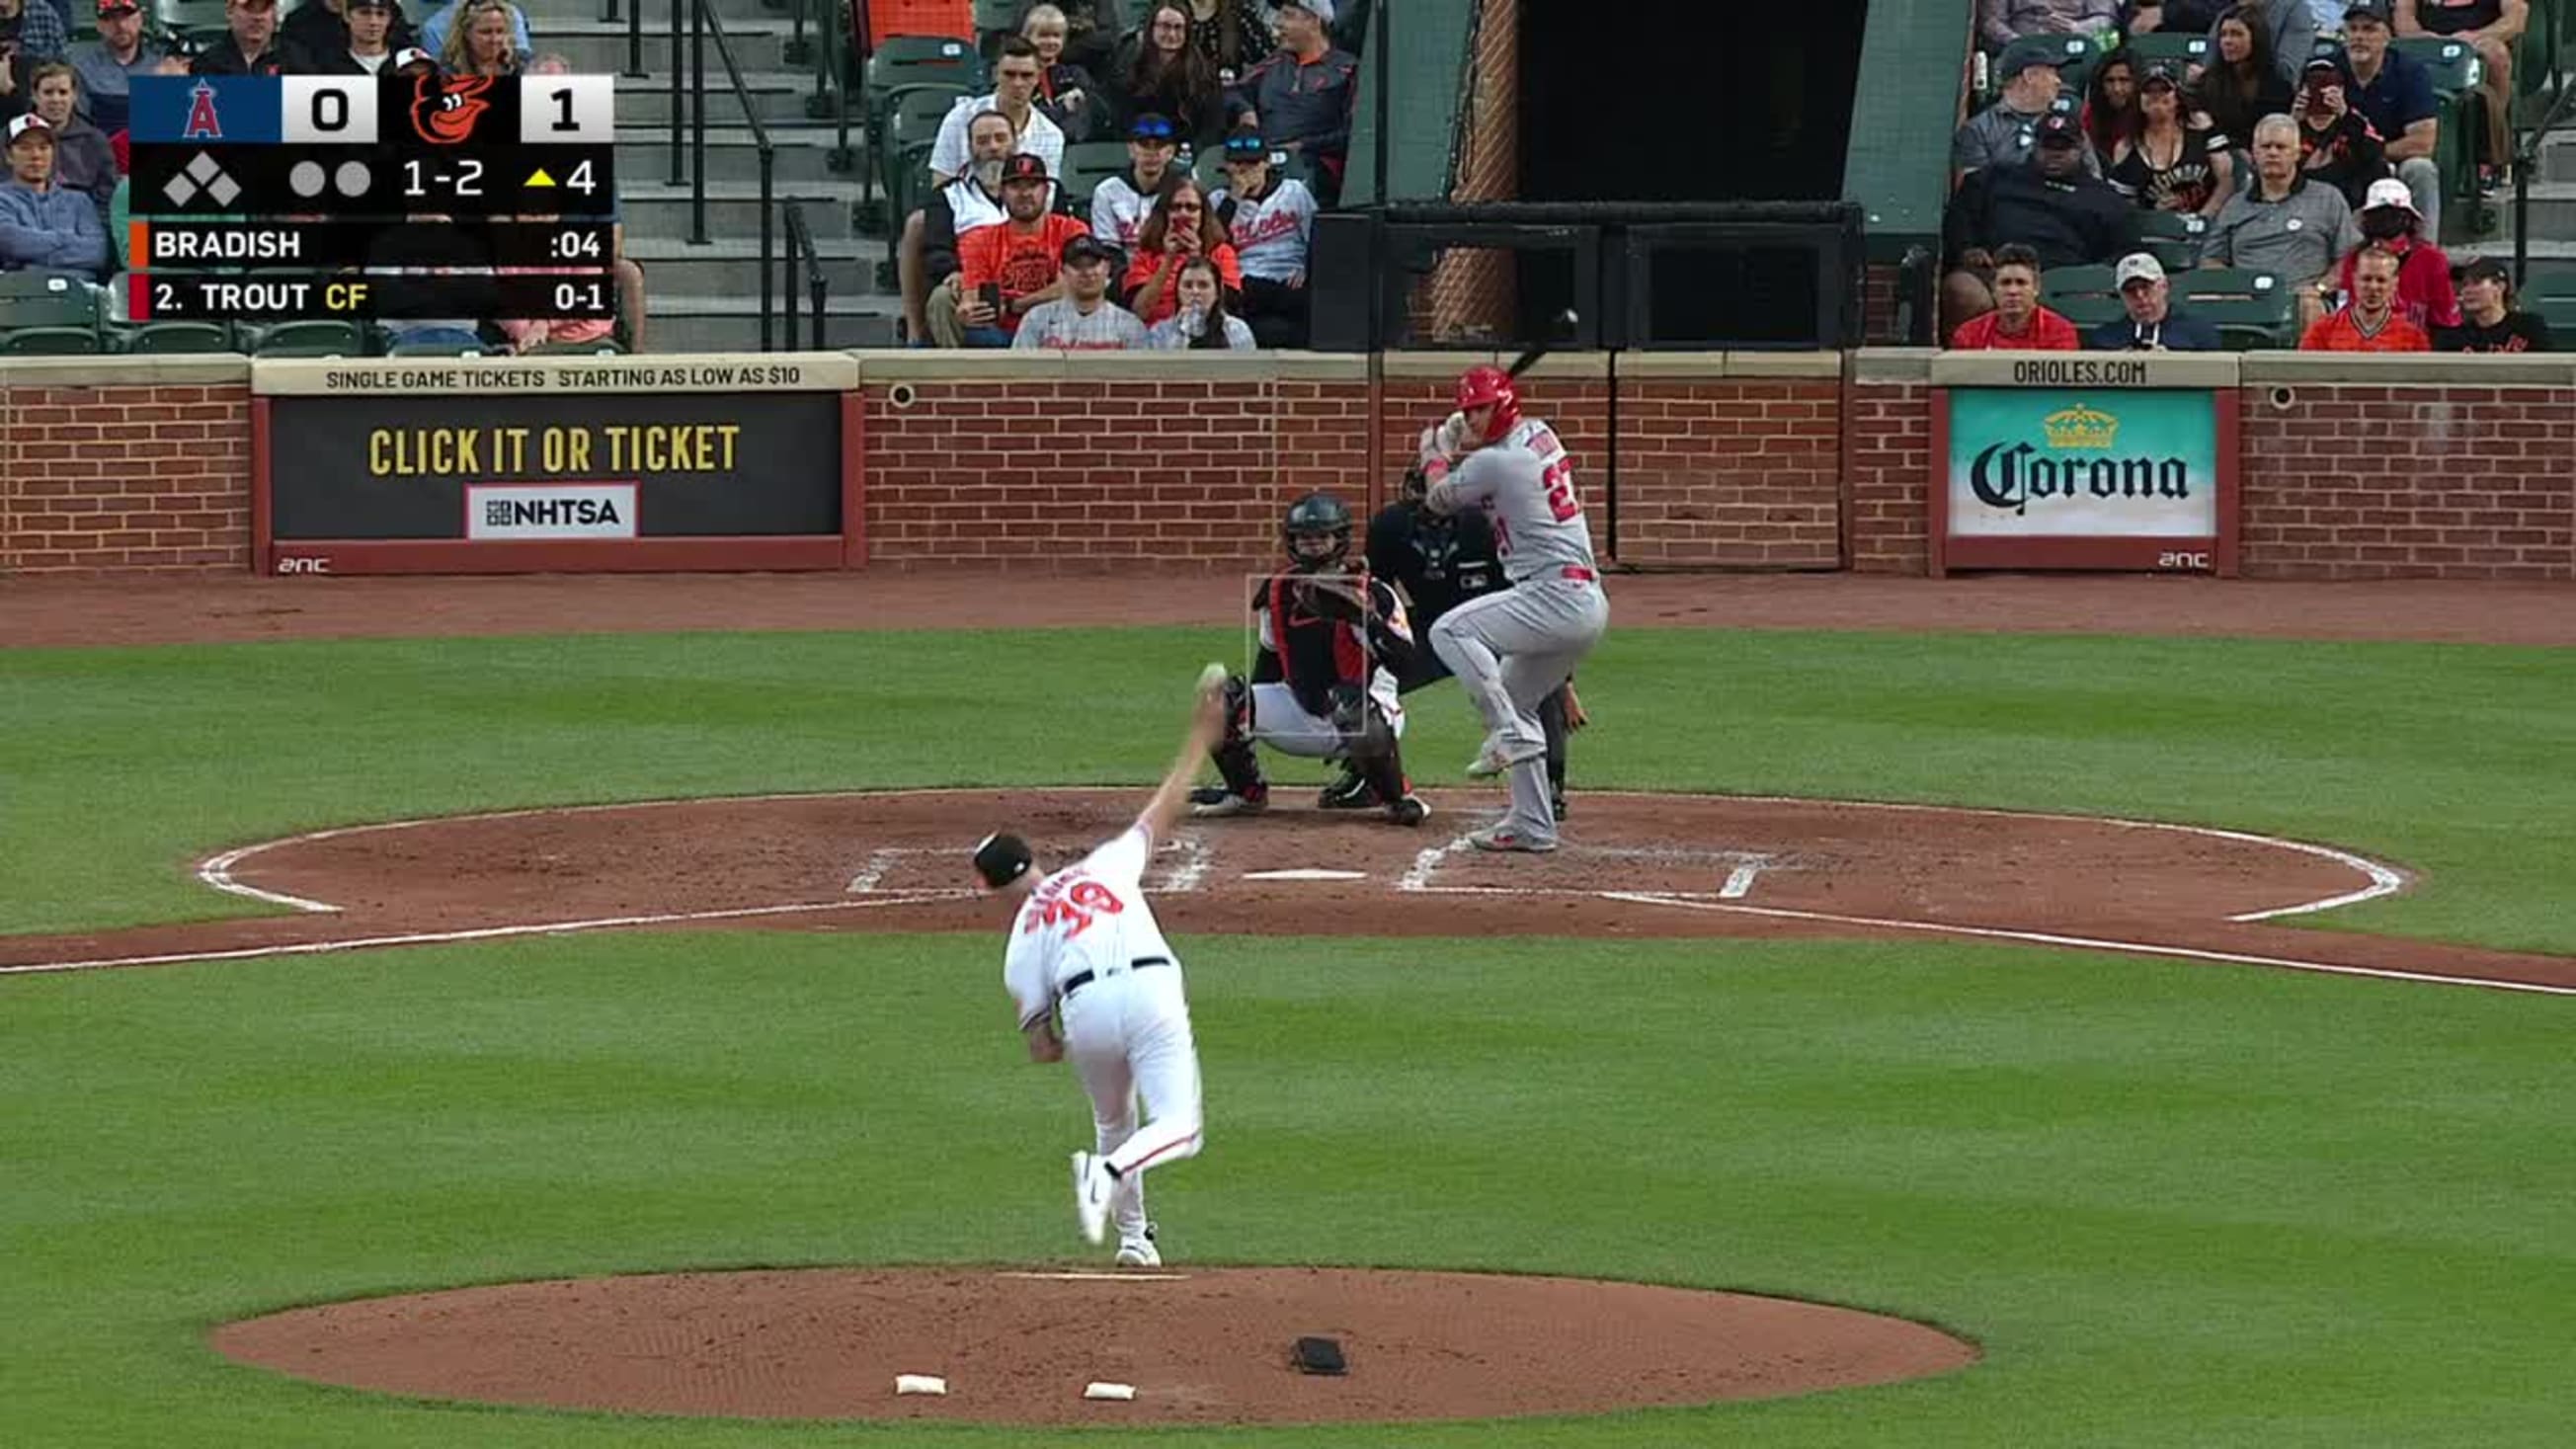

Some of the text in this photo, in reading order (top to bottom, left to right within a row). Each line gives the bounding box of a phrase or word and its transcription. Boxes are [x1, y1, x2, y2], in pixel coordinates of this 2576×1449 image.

[326, 365, 800, 388] SINGLE GAME TICKETS STARTING AS LOW AS $10
[2014, 361, 2146, 383] ORIOLES.COM
[368, 426, 741, 475] CLICK IT OR TICKET
[1971, 441, 2190, 516] Corona
[514, 499, 620, 525] NHTSA
[279, 557, 330, 573] anc
[2158, 552, 2209, 568] anc
